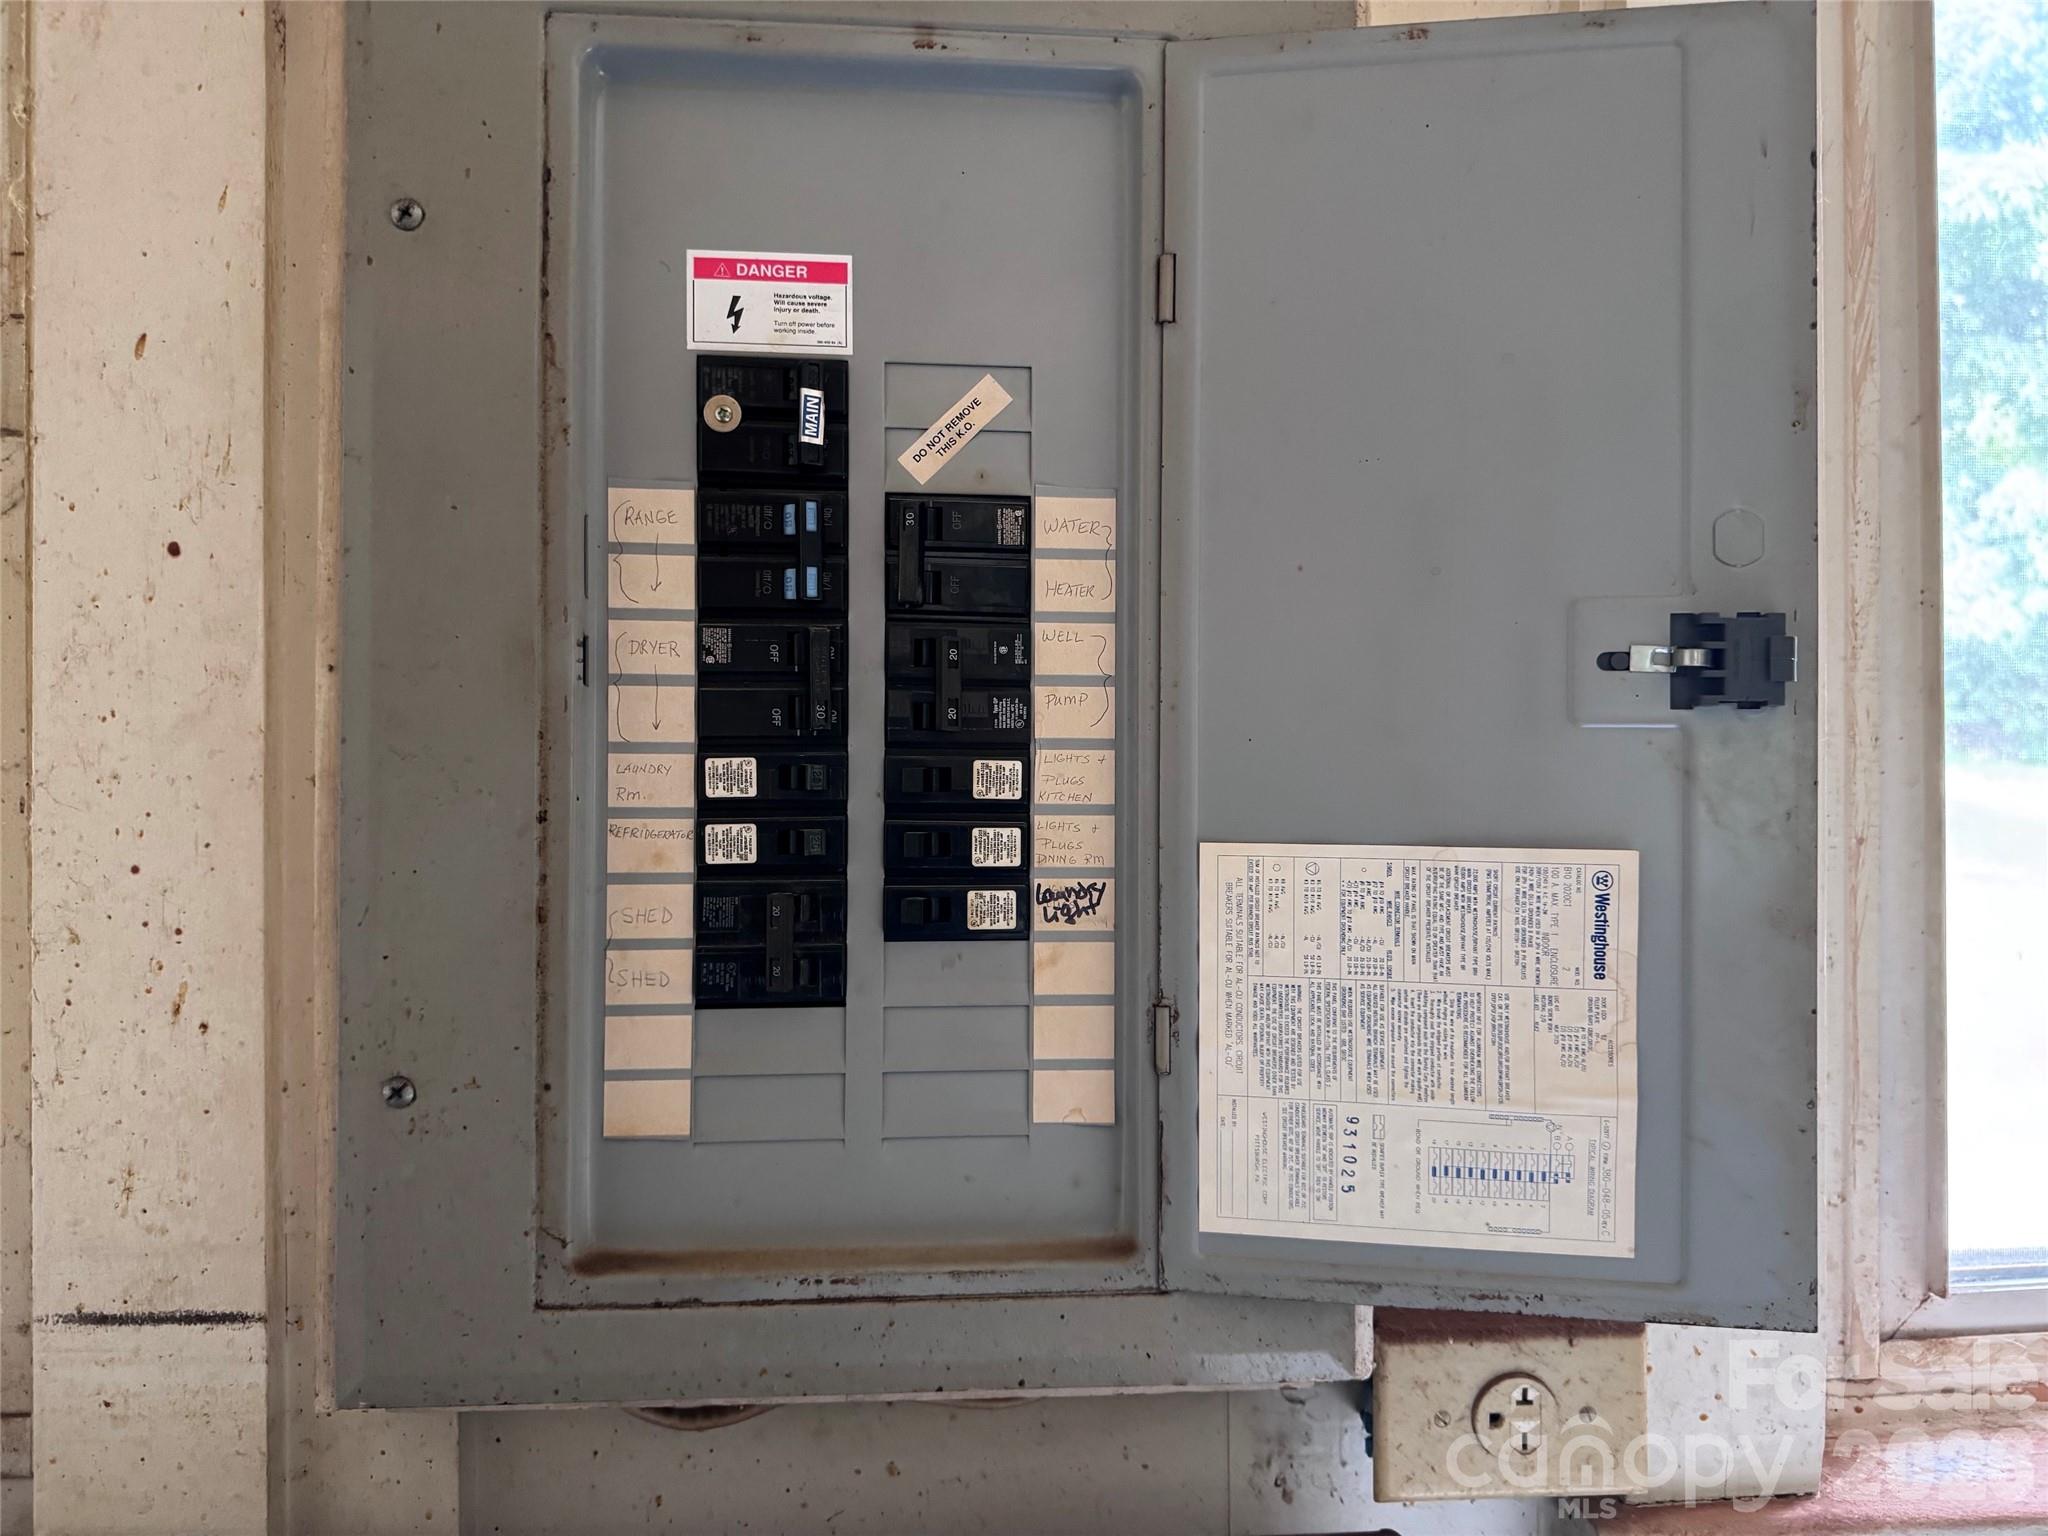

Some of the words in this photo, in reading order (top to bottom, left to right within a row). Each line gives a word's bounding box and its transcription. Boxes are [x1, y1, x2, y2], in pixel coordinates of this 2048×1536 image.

[736, 264, 808, 278] DANGER
[804, 396, 820, 438] MAIN
[912, 448, 928, 463] DO
[926, 430, 946, 450] NOT
[944, 398, 982, 432] REMOVE
[936, 437, 956, 456] THIS
[956, 422, 976, 438] K.O.
[624, 506, 678, 526] RANGE
[906, 512, 915, 526] 30
[952, 512, 962, 530] OFF
[1044, 518, 1101, 535] WATER
[950, 576, 960, 594] OFF
[1046, 580, 1095, 598] HEATER
[1042, 630, 1084, 642] WELL
[628, 640, 680, 657] DRYER
[769, 644, 779, 663] OFF
[949, 648, 958, 661] 20
[771, 708, 781, 727] OFF
[816, 704, 825, 719] 30
[948, 707, 957, 720] 20
[1044, 755, 1090, 764] LIGHTS
[616, 763, 672, 776] LAUNDRY
[1042, 775, 1085, 785] PLUGS
[1038, 792, 1094, 802] KITCHEN
[609, 823, 694, 840] REFRIDGERATOR
[1036, 820, 1080, 832] LIGHTS
[1036, 838, 1083, 850] PLUGS
[1036, 854, 1077, 864] DINING
[1551, 867, 1559, 878] 100
[622, 907, 673, 924] SHED
[772, 905, 781, 917] 20
[1550, 913, 1558, 927] TYPE
[1541, 932, 1549, 956] INDOOR
[1590, 893, 1609, 980] Westinghouse
[772, 966, 781, 977] 20
[1549, 948, 1558, 985] ENCLOSURE
[616, 970, 670, 987] SHED
[1224, 966, 1232, 988] AL-CU
